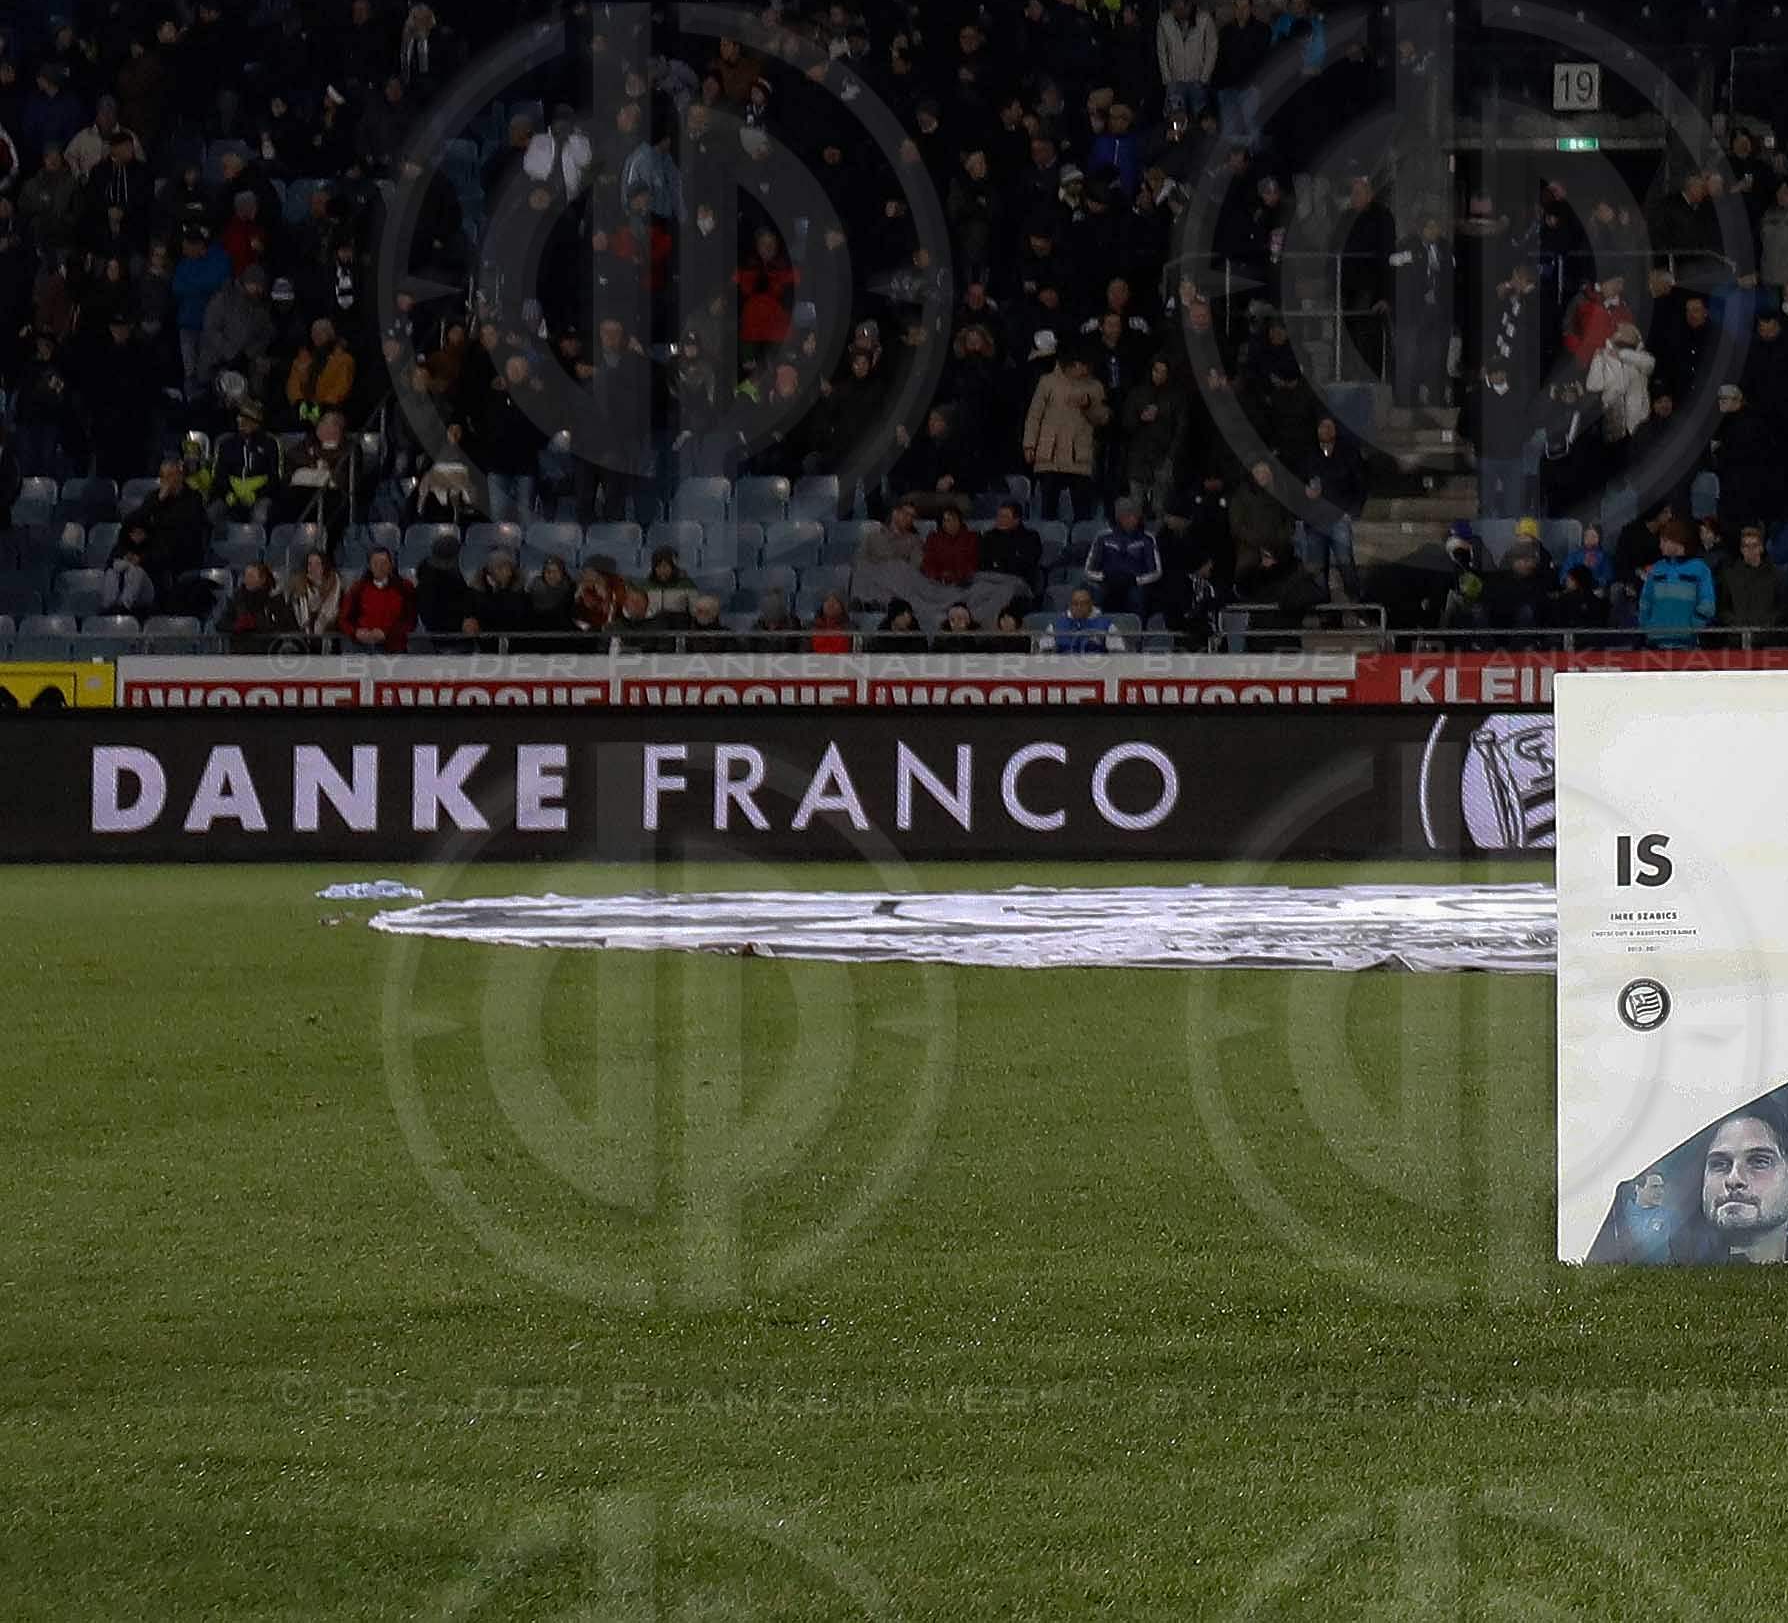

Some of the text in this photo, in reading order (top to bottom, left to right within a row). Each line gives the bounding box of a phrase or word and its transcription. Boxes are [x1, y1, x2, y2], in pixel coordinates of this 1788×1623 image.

[1559, 70, 1594, 103] 19
[1399, 665, 1621, 704] KLEI
[91, 739, 1181, 834] DANKE FRANCO
[1617, 834, 1673, 887] IS
